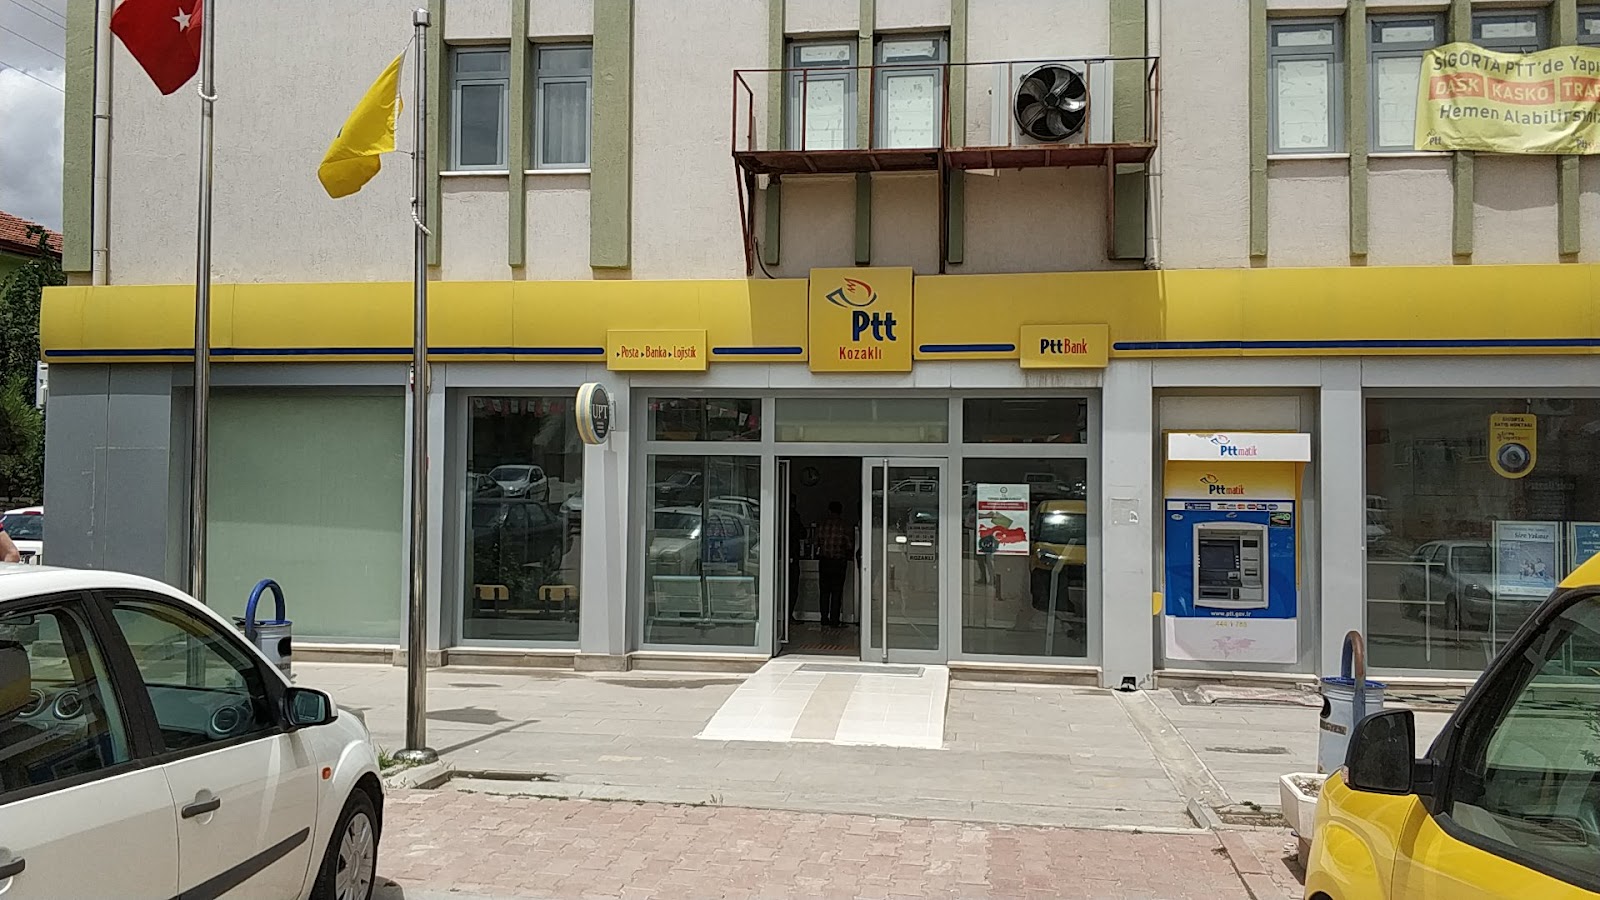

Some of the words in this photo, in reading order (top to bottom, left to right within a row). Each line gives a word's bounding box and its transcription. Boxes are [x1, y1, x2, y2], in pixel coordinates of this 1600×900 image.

[1505, 58, 1563, 77] PTT'de
[1435, 77, 1479, 95] DASK
[1492, 83, 1549, 101] KASKO
[1440, 105, 1499, 120] Hemen
[852, 310, 897, 342] Ptt
[621, 345, 639, 358] Posta
[645, 345, 667, 358] Banka
[673, 345, 696, 360] Lojistik
[839, 346, 882, 360] Kozaklı
[592, 403, 608, 419] UPT
